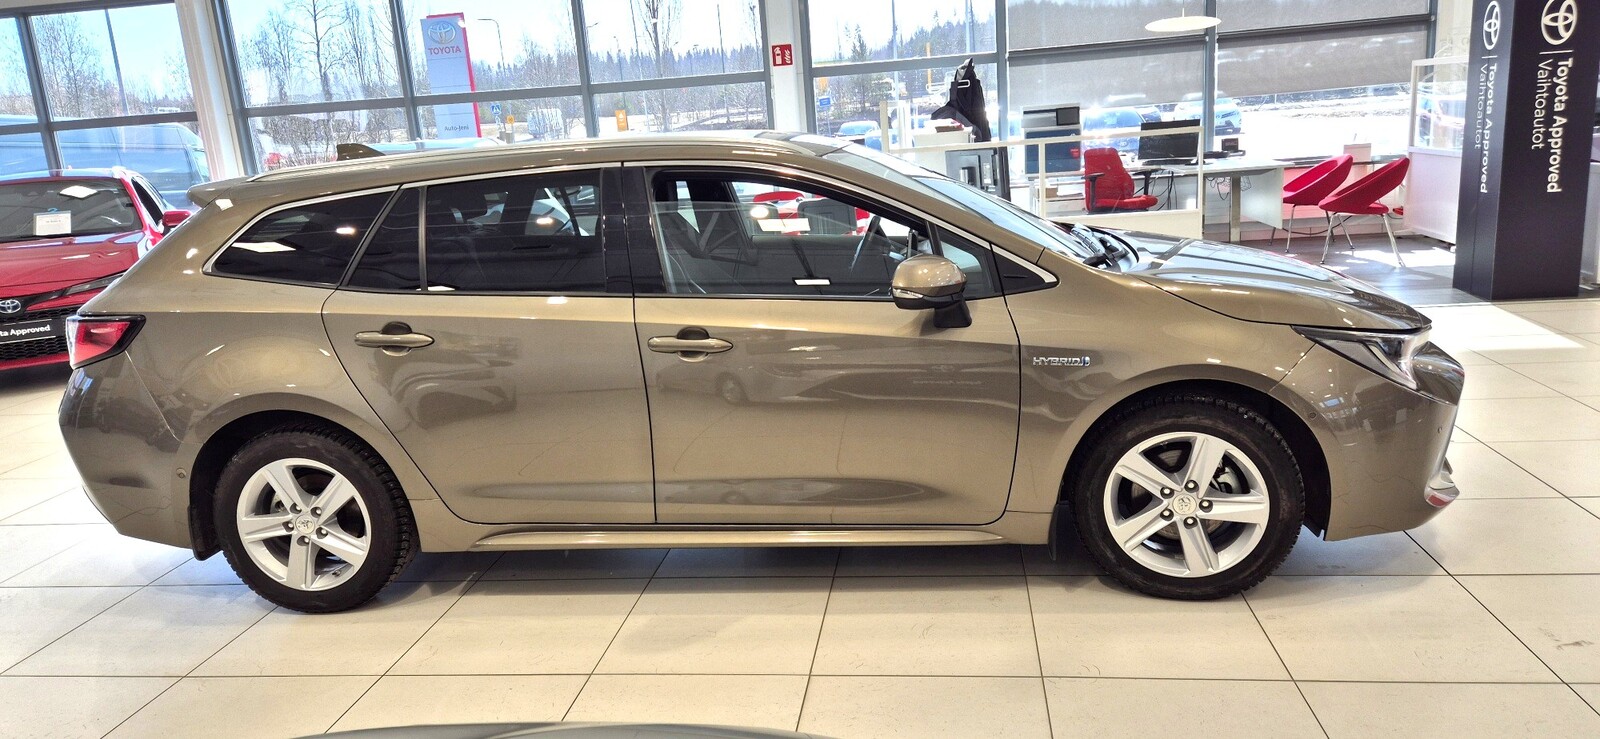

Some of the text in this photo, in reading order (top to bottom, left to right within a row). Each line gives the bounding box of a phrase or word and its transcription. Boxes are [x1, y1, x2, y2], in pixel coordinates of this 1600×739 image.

[428, 45, 461, 55] TOYOTA
[1474, 64, 1488, 149] Vaihtoautot
[1479, 63, 1497, 193] Toyota Approved
[1531, 59, 1552, 150] Vaihtoautot
[1546, 57, 1574, 193] Toyota Approved
[10, 324, 51, 336] Approved
[1033, 356, 1082, 366] HYBRID
